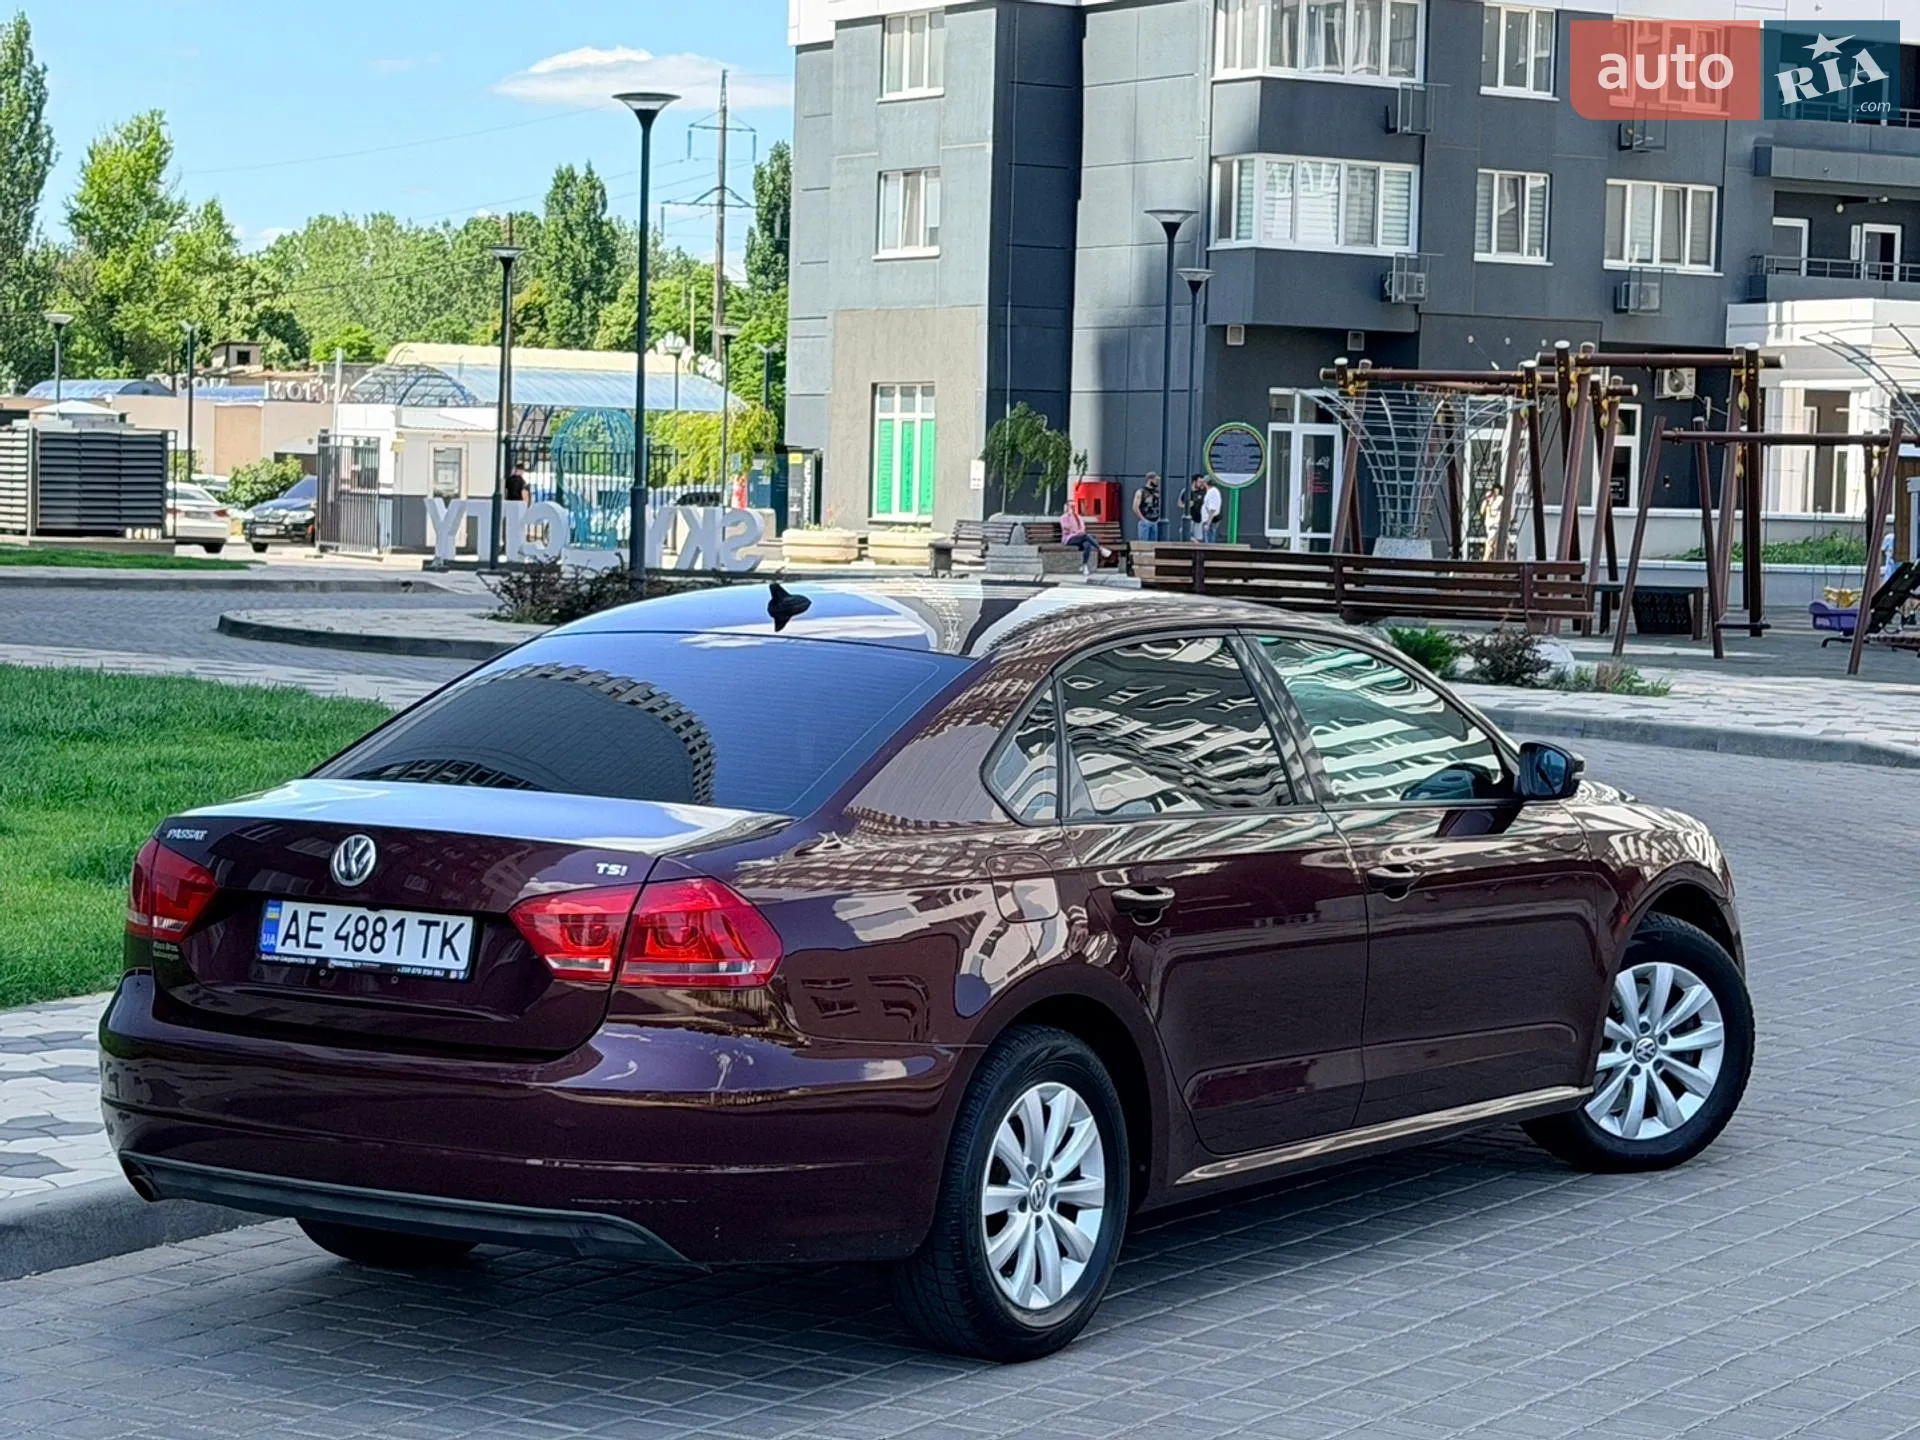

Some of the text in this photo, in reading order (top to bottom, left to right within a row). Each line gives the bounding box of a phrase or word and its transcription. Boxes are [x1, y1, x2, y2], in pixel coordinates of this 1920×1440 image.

[166, 828, 208, 841] PASSAT
[596, 862, 628, 876] TSI
[262, 933, 276, 946] UA
[281, 909, 465, 962] AE 4881 TK
